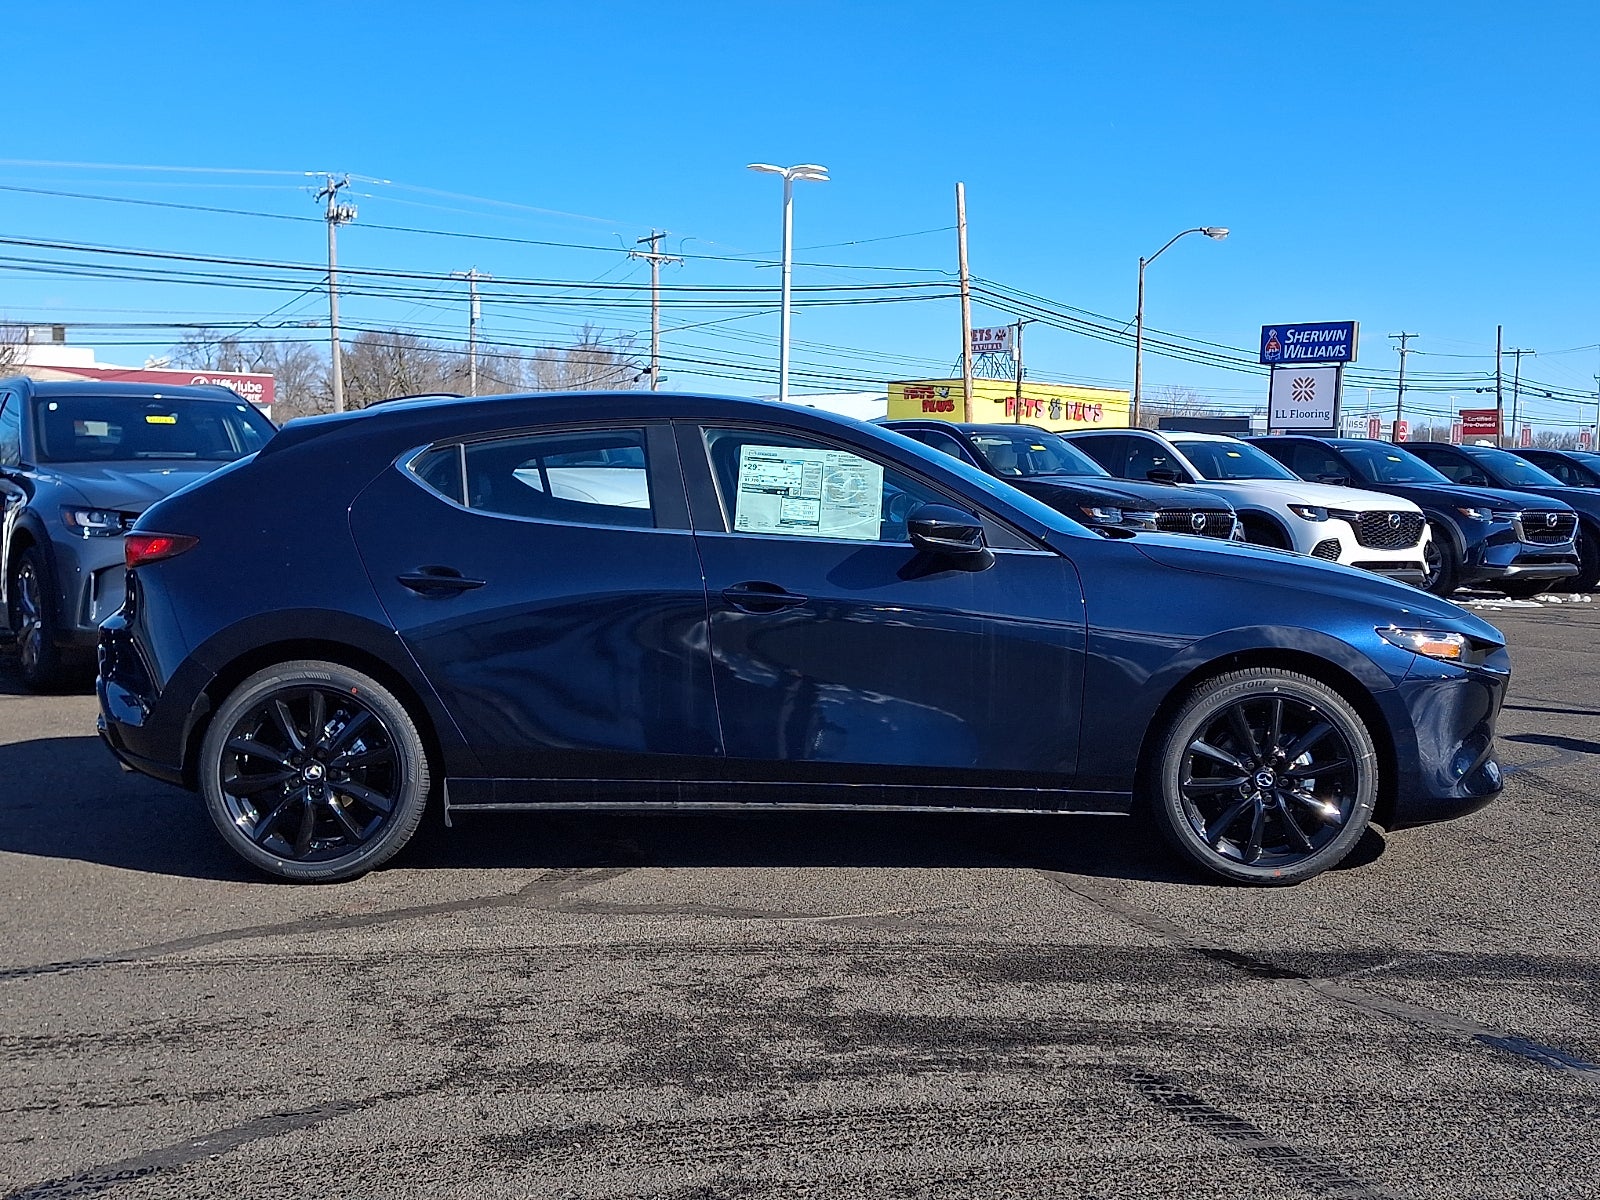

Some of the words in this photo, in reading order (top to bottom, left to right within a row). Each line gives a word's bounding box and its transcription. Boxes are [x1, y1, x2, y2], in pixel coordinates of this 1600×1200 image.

[970, 329, 992, 341] ETS
[1284, 329, 1347, 344] SHERWIN
[1283, 344, 1347, 359] WILLIAMS
[903, 386, 935, 400] PETS
[922, 399, 955, 413] PLUS
[1005, 396, 1045, 418] PETS
[1065, 401, 1104, 422] PLUS
[1275, 409, 1288, 419] LL
[1290, 408, 1330, 421] Flooring
